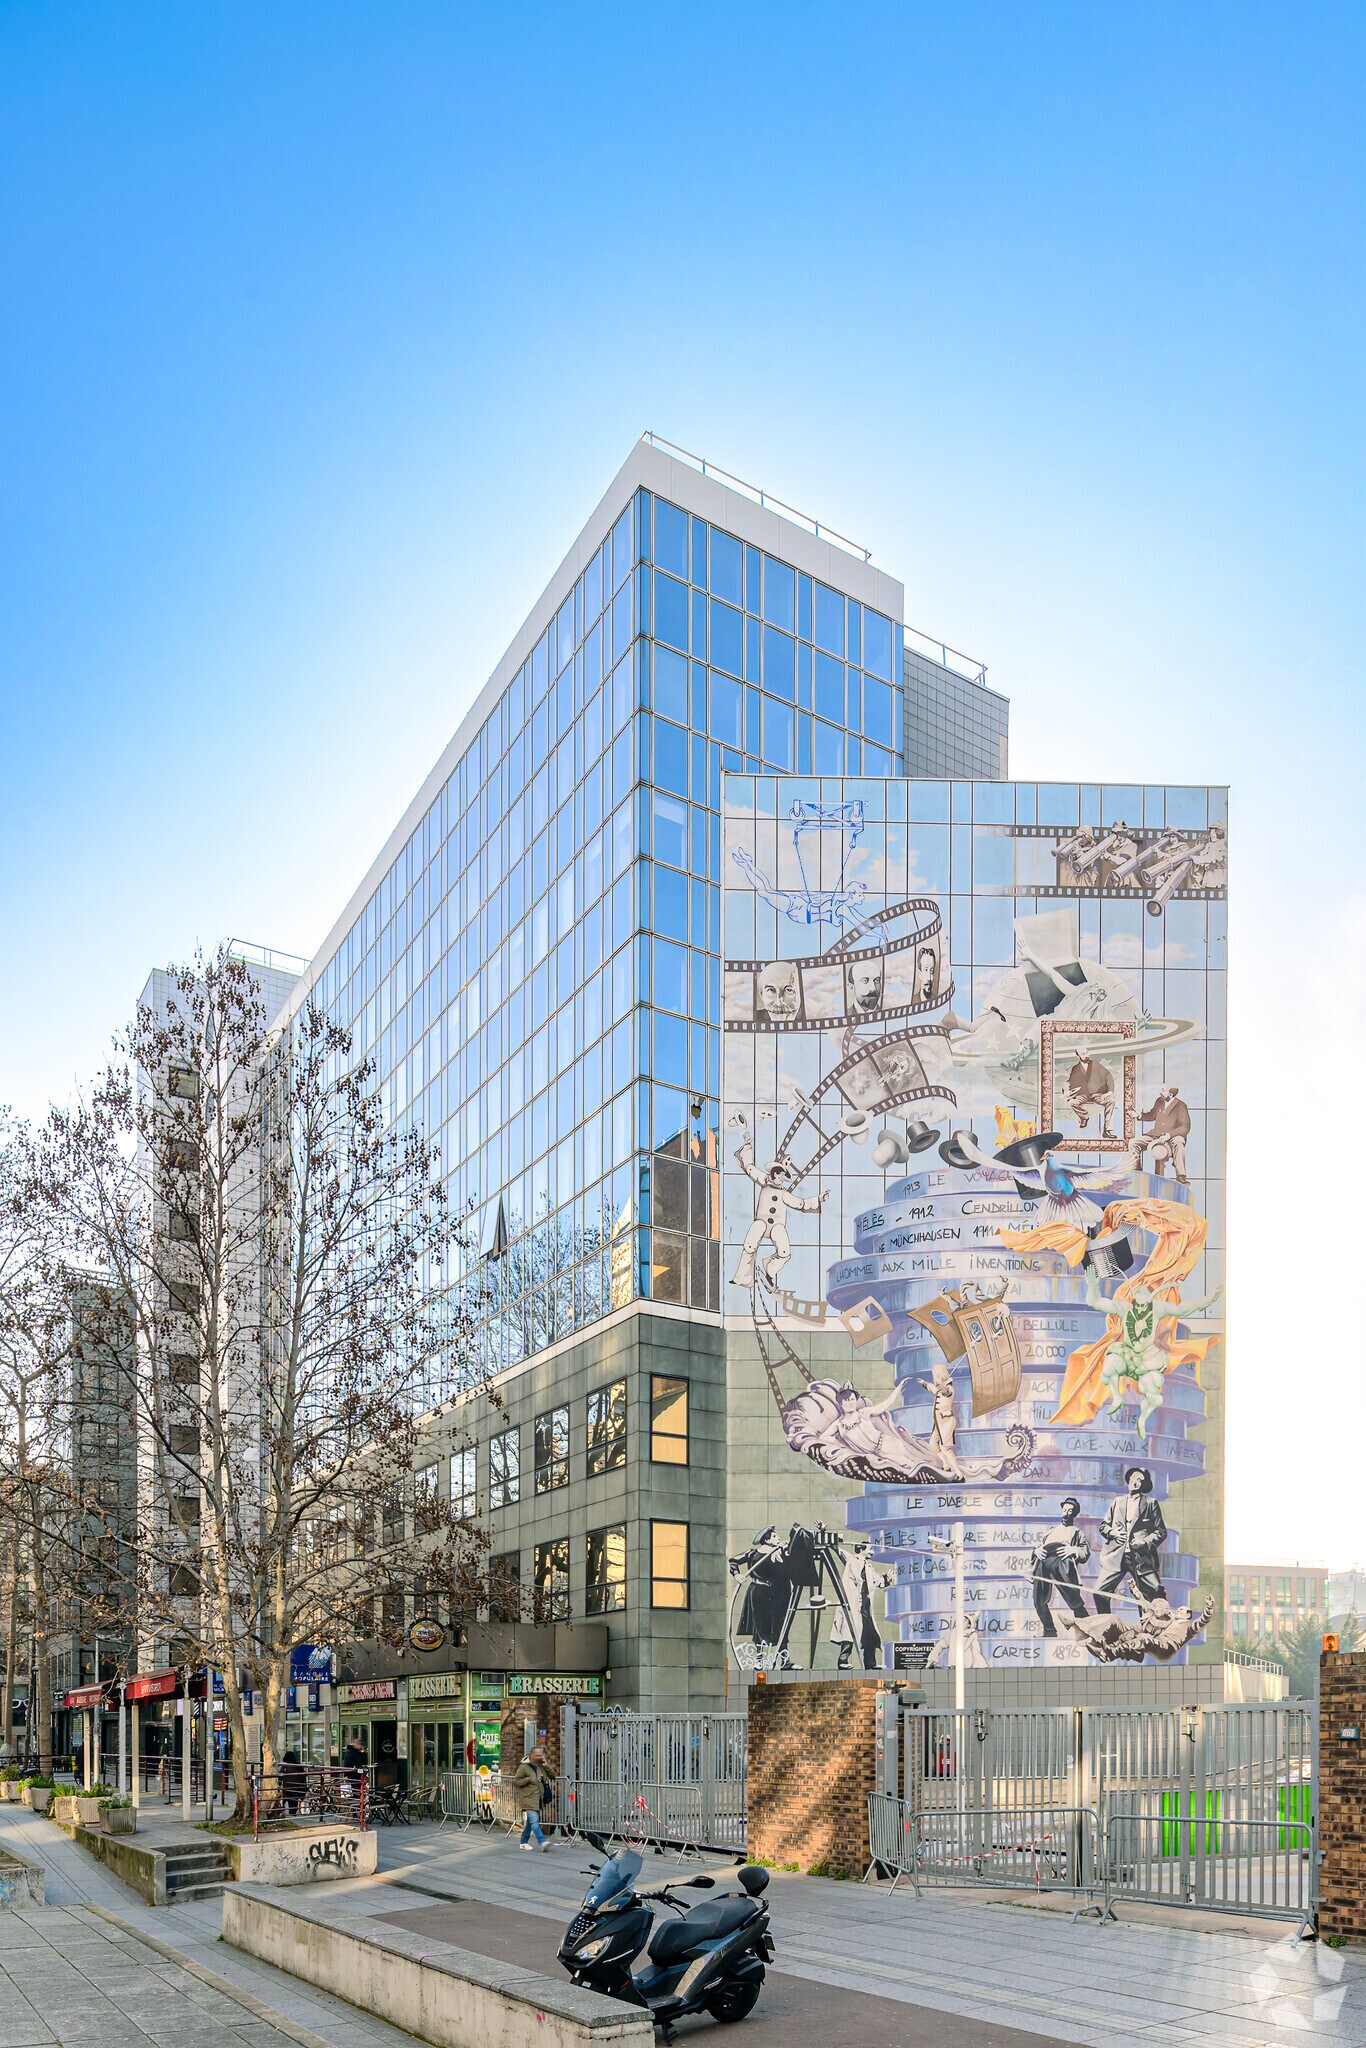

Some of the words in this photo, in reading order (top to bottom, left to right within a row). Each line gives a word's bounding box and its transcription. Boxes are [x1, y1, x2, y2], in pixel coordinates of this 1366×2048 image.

[902, 1181, 921, 1197] 1913
[927, 1174, 946, 1187] LE
[908, 1204, 935, 1220] 1912
[881, 1260, 905, 1273] AUX
[907, 1498, 924, 1510] LE
[938, 1493, 983, 1508] DIABLE
[1051, 1644, 1082, 1660] 1896
[408, 1674, 458, 1699] BRASSERIE
[510, 1677, 600, 1694] BRASSERIE
